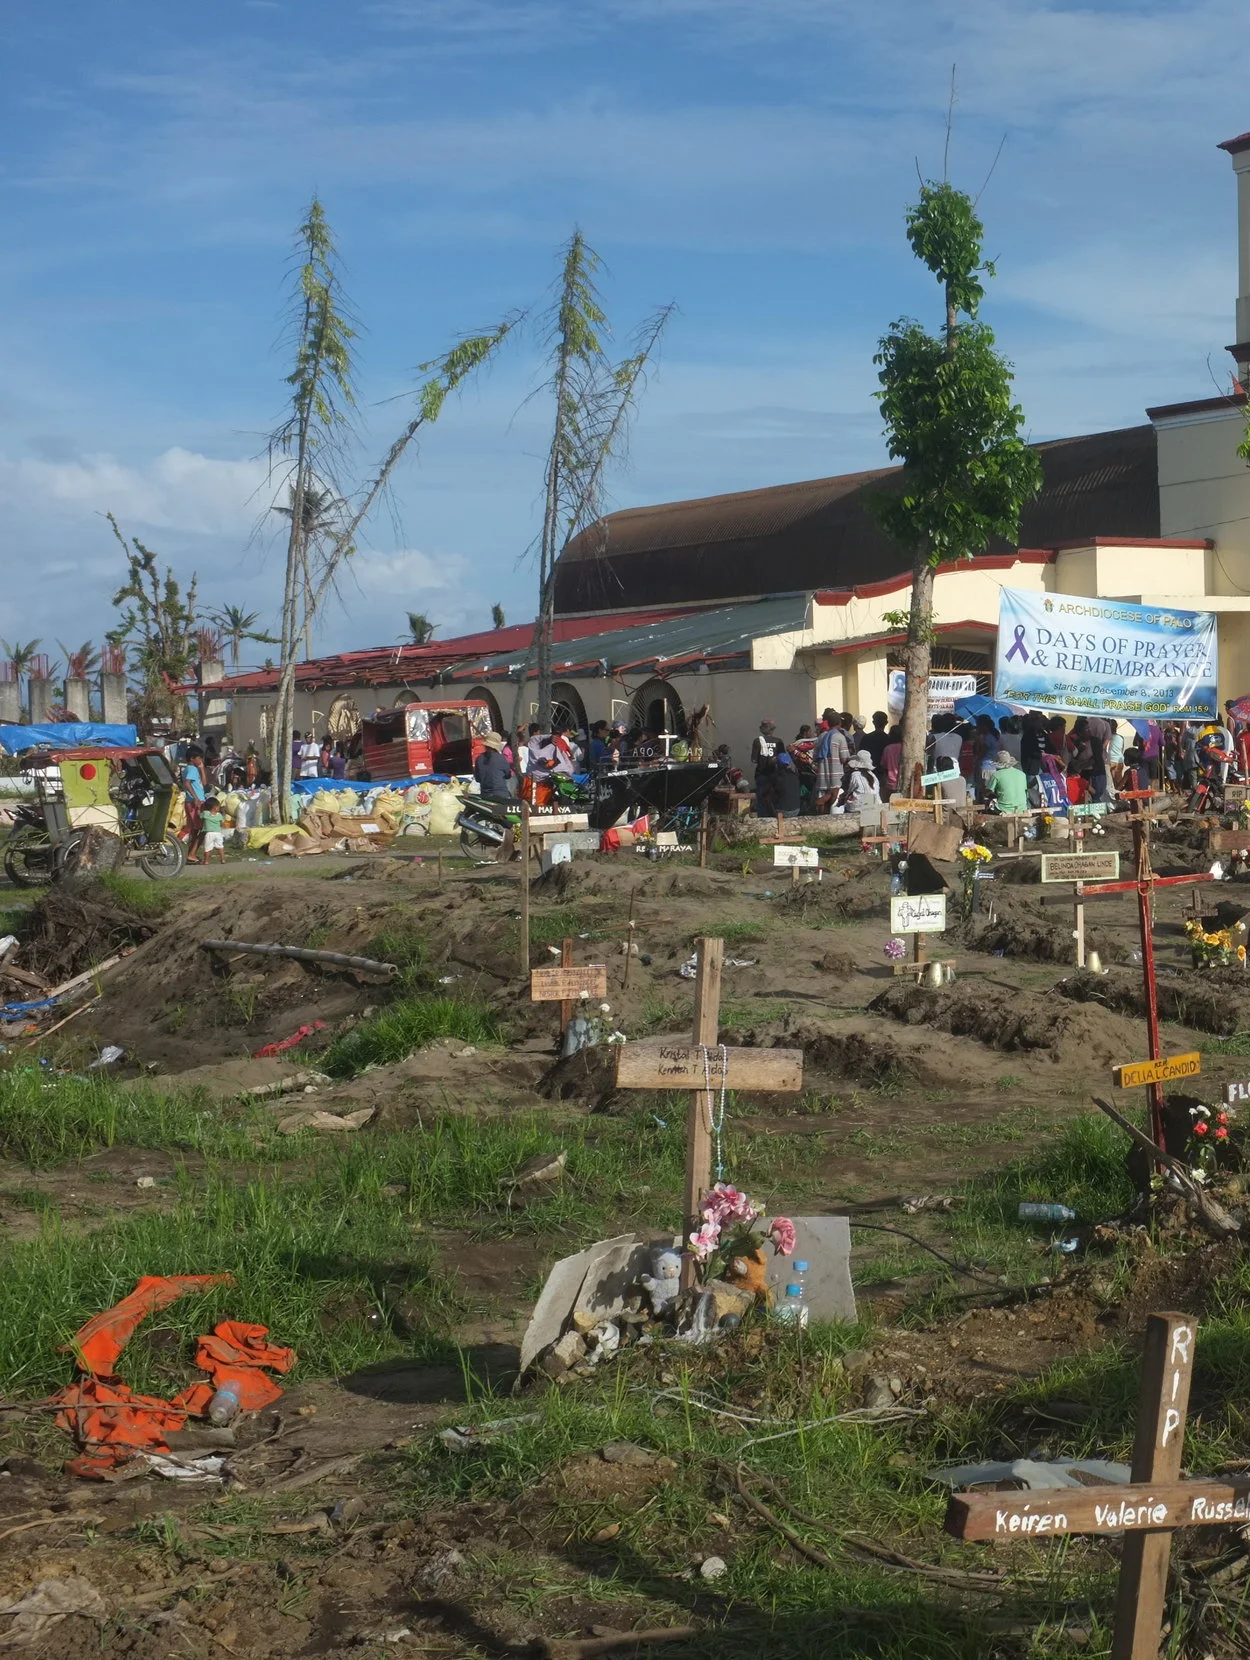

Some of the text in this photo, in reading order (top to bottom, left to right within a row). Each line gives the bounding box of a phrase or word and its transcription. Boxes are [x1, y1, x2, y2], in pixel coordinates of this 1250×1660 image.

[1058, 603, 1192, 629] ARCHDIOCESE OF PALO
[1035, 627, 1208, 659] DAYS OF PRAYER
[1031, 649, 1212, 678] & REMEMBRANCE
[1031, 691, 1056, 704] THIS
[1058, 695, 1063, 705] I
[1065, 695, 1100, 710] SHALL
[1101, 699, 1142, 713] PRAISE
[1053, 682, 1174, 698] starts on December 8, 2013
[1049, 862, 1074, 871] BELINDA
[1095, 1497, 1168, 1528] Valerie
